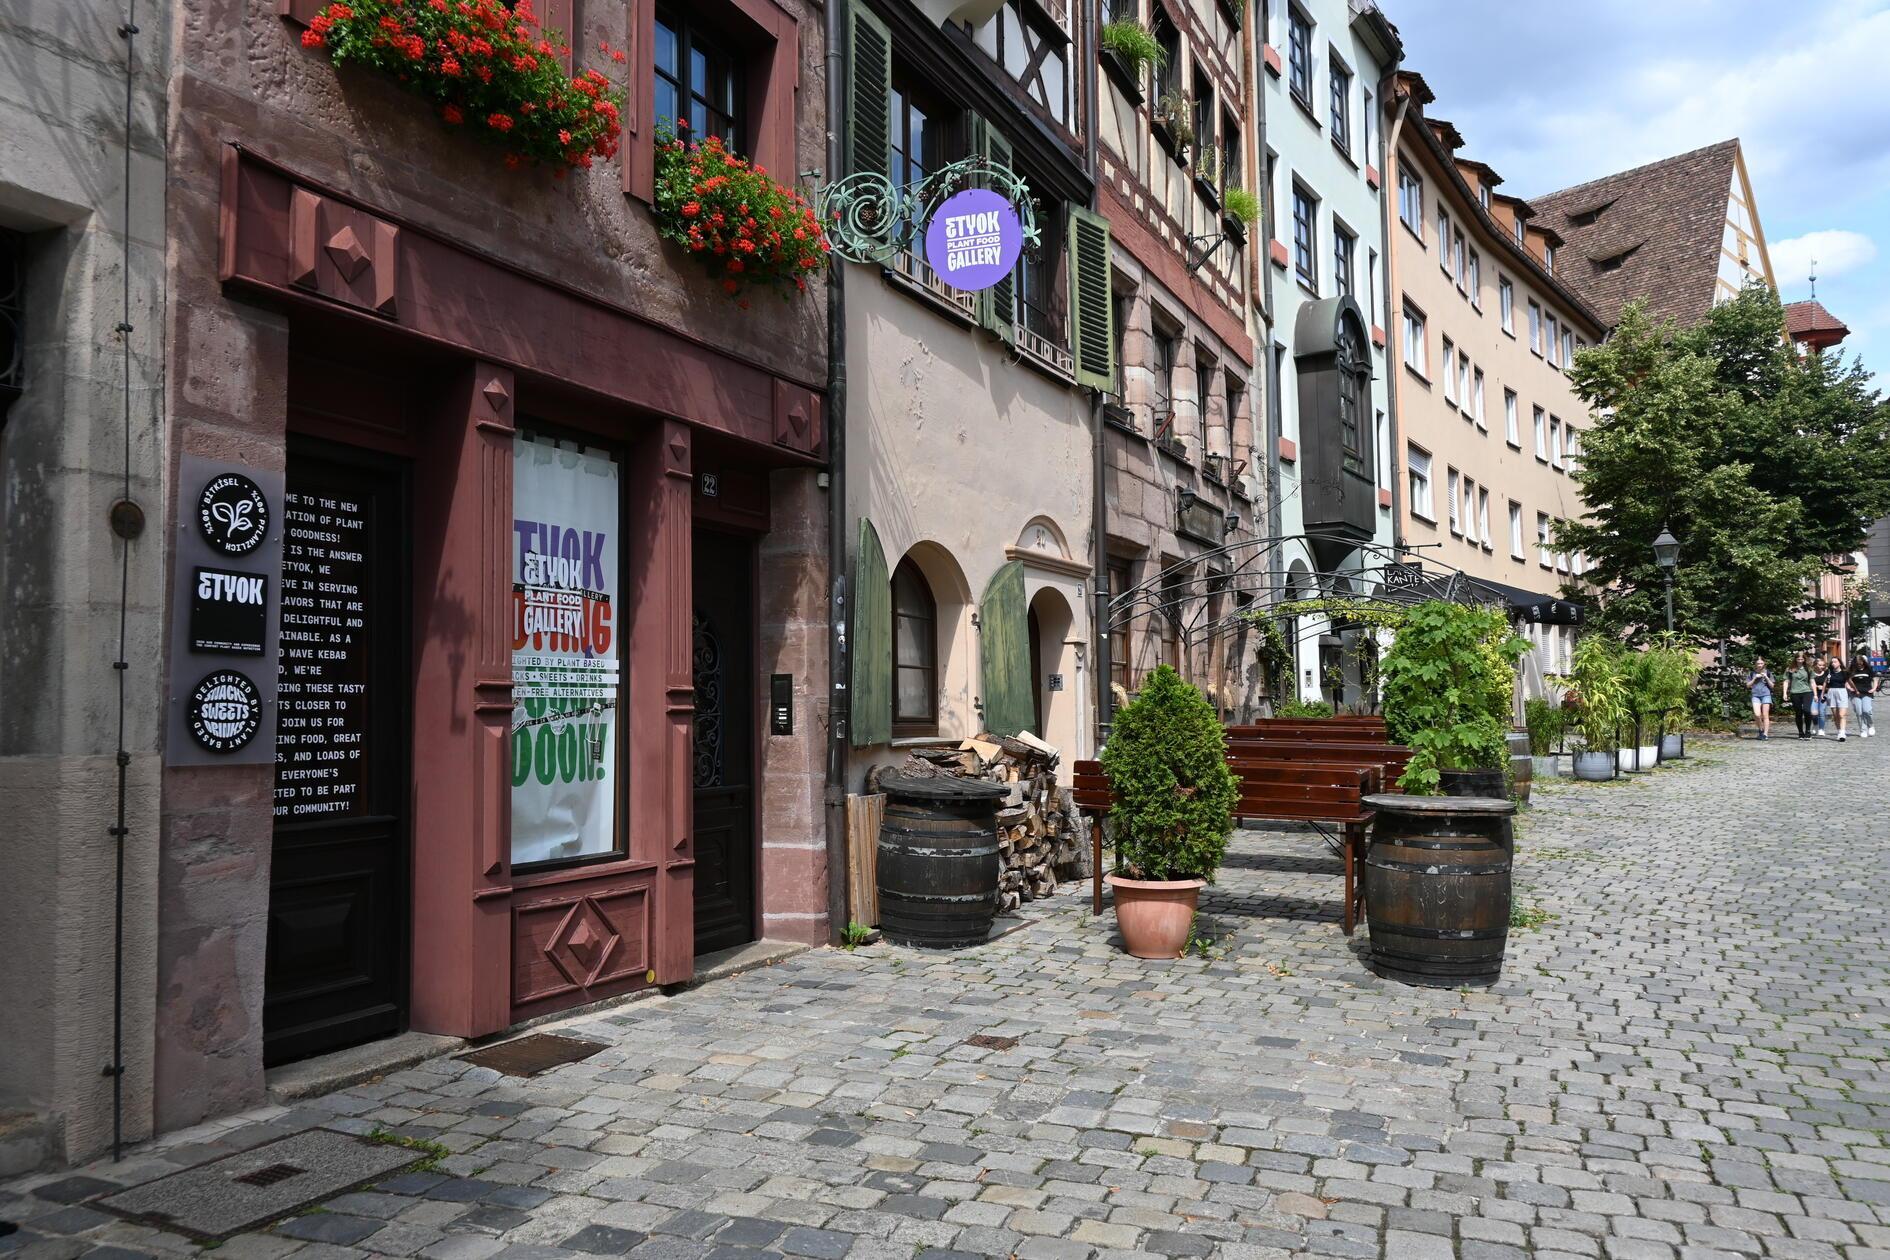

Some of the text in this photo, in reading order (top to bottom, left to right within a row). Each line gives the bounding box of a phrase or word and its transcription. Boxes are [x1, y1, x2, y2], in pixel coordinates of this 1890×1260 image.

[945, 211, 1000, 238] ETYOK
[947, 236, 1000, 250] PLANT FOOD
[948, 246, 1001, 272] GALLERY
[303, 496, 314, 505] TO
[319, 498, 336, 509] THE
[341, 502, 358, 512] NEW
[320, 516, 332, 524] OF
[336, 518, 363, 529] PLANT
[225, 519, 266, 552] PFLANZLICH
[291, 528, 340, 543] GOODNESS!
[291, 545, 302, 554] IS
[307, 547, 324, 557] THE
[329, 550, 362, 562] ANSWER
[319, 565, 331, 574] WE
[524, 552, 582, 588] ETYOK
[1387, 575, 1420, 584] KANTE
[198, 572, 263, 605] ETYOK
[302, 580, 314, 590] IN
[319, 583, 358, 594] SERVING
[525, 591, 580, 605] PLANT FOOD
[320, 600, 342, 609] THAT
[347, 602, 363, 611] ARE
[284, 614, 363, 627] DELIGHTFUL AND
[524, 606, 582, 638] GALLERY
[330, 634, 340, 642] AS
[345, 634, 351, 643] A
[290, 648, 313, 658] WAVE
[318, 650, 346, 660] KEBAB
[545, 658, 554, 666] BY
[294, 665, 322, 675] WE'RE
[539, 673, 567, 681] SWEETS
[576, 674, 602, 682] DRINKS
[196, 675, 252, 700] DELIGHTED
[204, 685, 248, 703] SNACKS
[306, 684, 334, 693] THESE
[338, 684, 365, 693] TASTY
[553, 688, 603, 696] ALTERNATIVES
[201, 702, 250, 720] SWEETS
[250, 699, 258, 713] BY
[295, 701, 330, 710] CLOSER
[335, 701, 346, 710] TO
[203, 720, 246, 738] DRINKS
[282, 718, 344, 727] JOIN US FOR
[194, 722, 222, 748] BASED
[229, 720, 256, 748] PLANT
[276, 734, 361, 745] ING FOOD, GREAT
[294, 752, 312, 761] AND
[317, 751, 345, 760] LOADS
[349, 750, 360, 759] OF
[282, 768, 338, 780] EVERYONE'S
[301, 787, 312, 796] TO
[318, 786, 328, 795] BE
[334, 784, 356, 794] PART
[294, 802, 349, 814] COMMUNITY!
